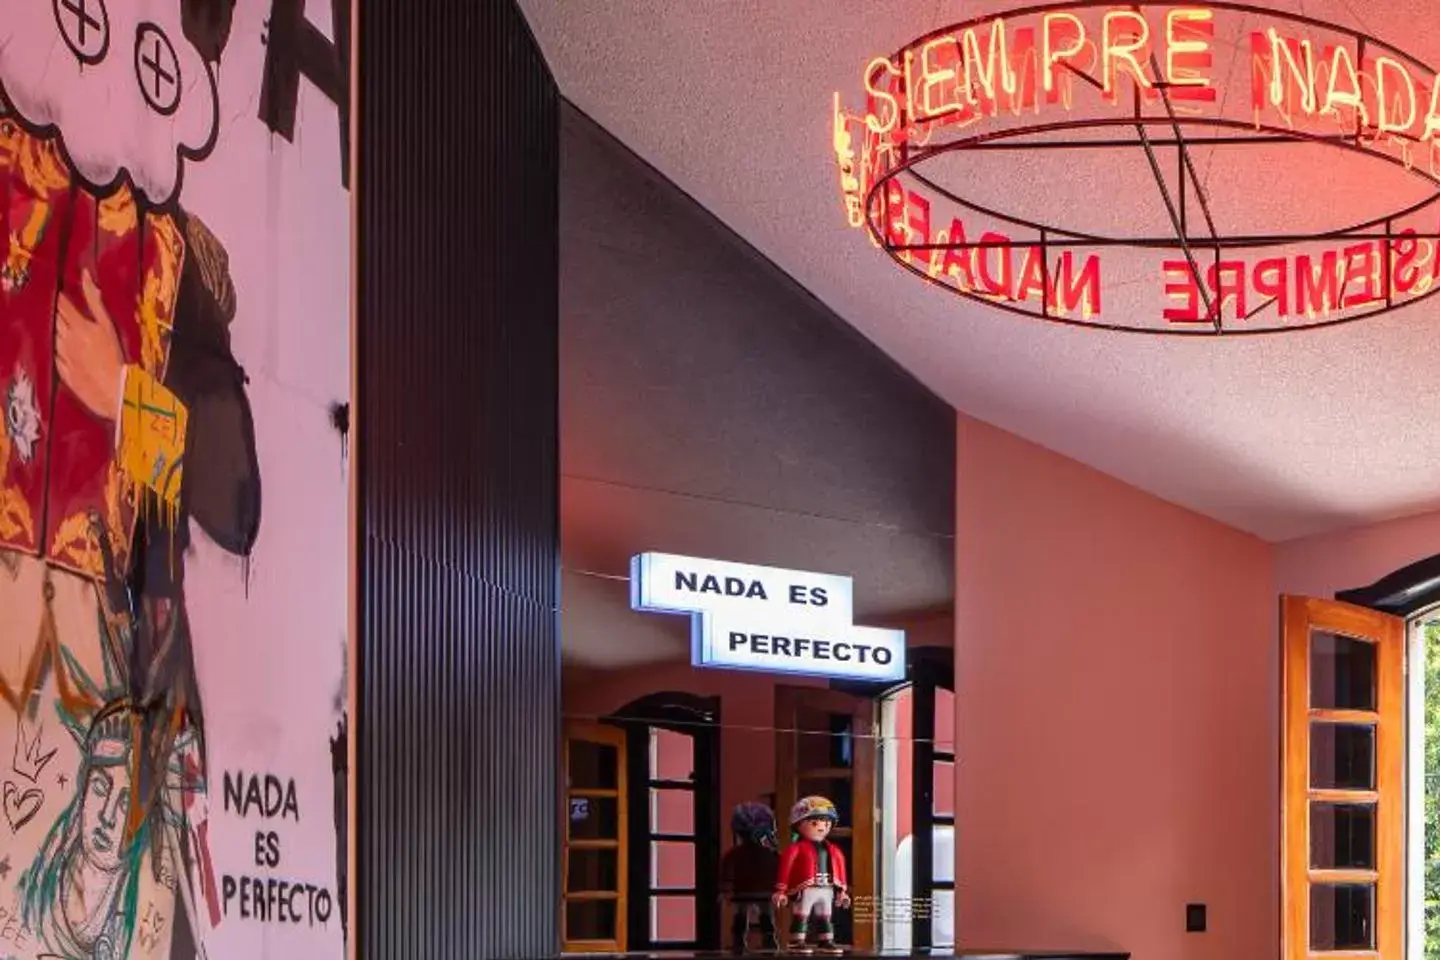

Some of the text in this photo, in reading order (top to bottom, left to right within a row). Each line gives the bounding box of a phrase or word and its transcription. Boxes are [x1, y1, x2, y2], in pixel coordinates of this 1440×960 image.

[864, 8, 1212, 133] SIEMPRE
[674, 570, 829, 607] NADA ES
[729, 631, 893, 665] PERFECTO
[223, 769, 300, 822] NADA
[254, 830, 281, 869] ES
[221, 874, 332, 928] PERFECTO
